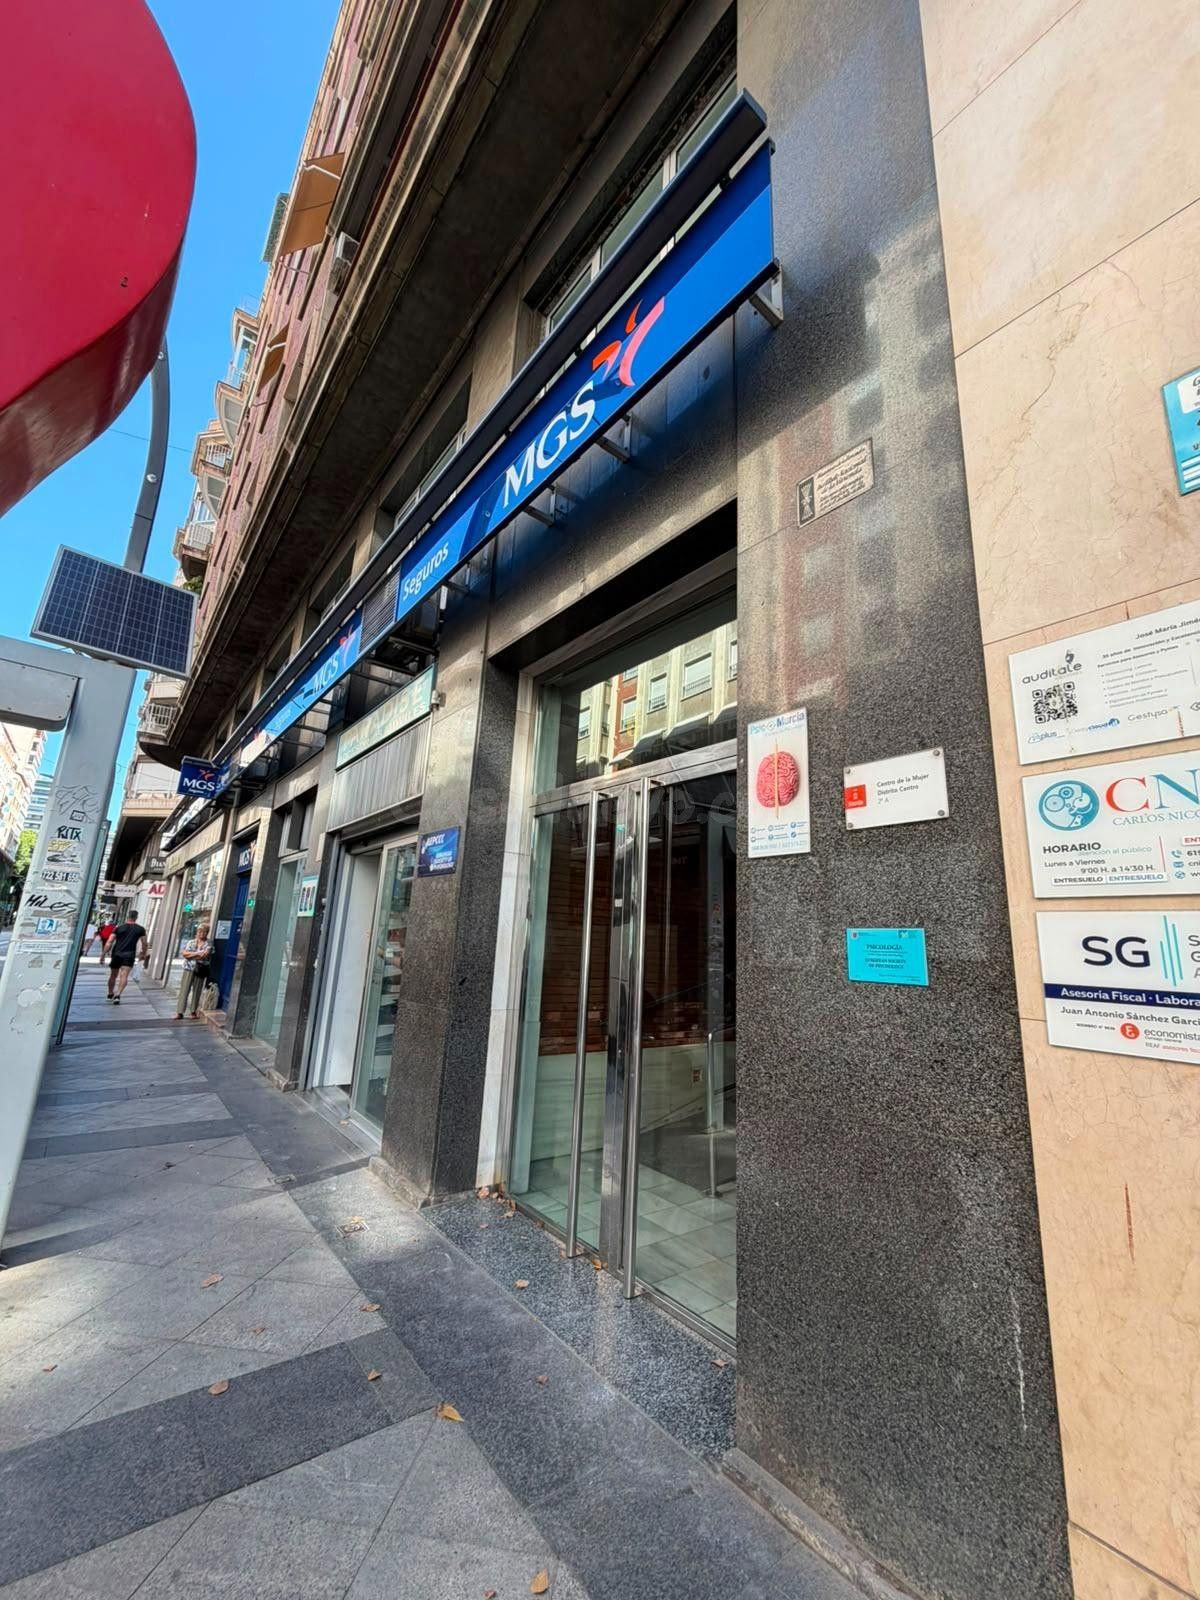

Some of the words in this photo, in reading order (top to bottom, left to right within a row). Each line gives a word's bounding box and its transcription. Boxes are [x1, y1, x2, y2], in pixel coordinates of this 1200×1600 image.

[502, 379, 597, 509] MGS
[402, 542, 449, 601] Seguros
[1135, 631, 1154, 640] José
[313, 649, 340, 692] MGS
[182, 777, 216, 792] MGS
[877, 779, 896, 788] Centro
[912, 773, 929, 782] Mujer
[877, 787, 898, 796] Distrito
[899, 784, 919, 793] Centro
[1112, 813, 1165, 827] CARLOS
[1042, 842, 1101, 854] HORARIO
[1044, 860, 1067, 868] Lunes
[1075, 859, 1106, 867] Viernes
[1053, 876, 1104, 884] ENTRESUELO
[1108, 873, 1165, 882] ENTRESUELO
[1081, 935, 1151, 968] SG
[1060, 987, 1110, 1000] Asesoría
[1111, 991, 1147, 1003] Fiscal
[1060, 1006, 1083, 1015] Juan
[1085, 1008, 1125, 1020] Antonio
[1125, 1011, 1169, 1024] Sánchez
